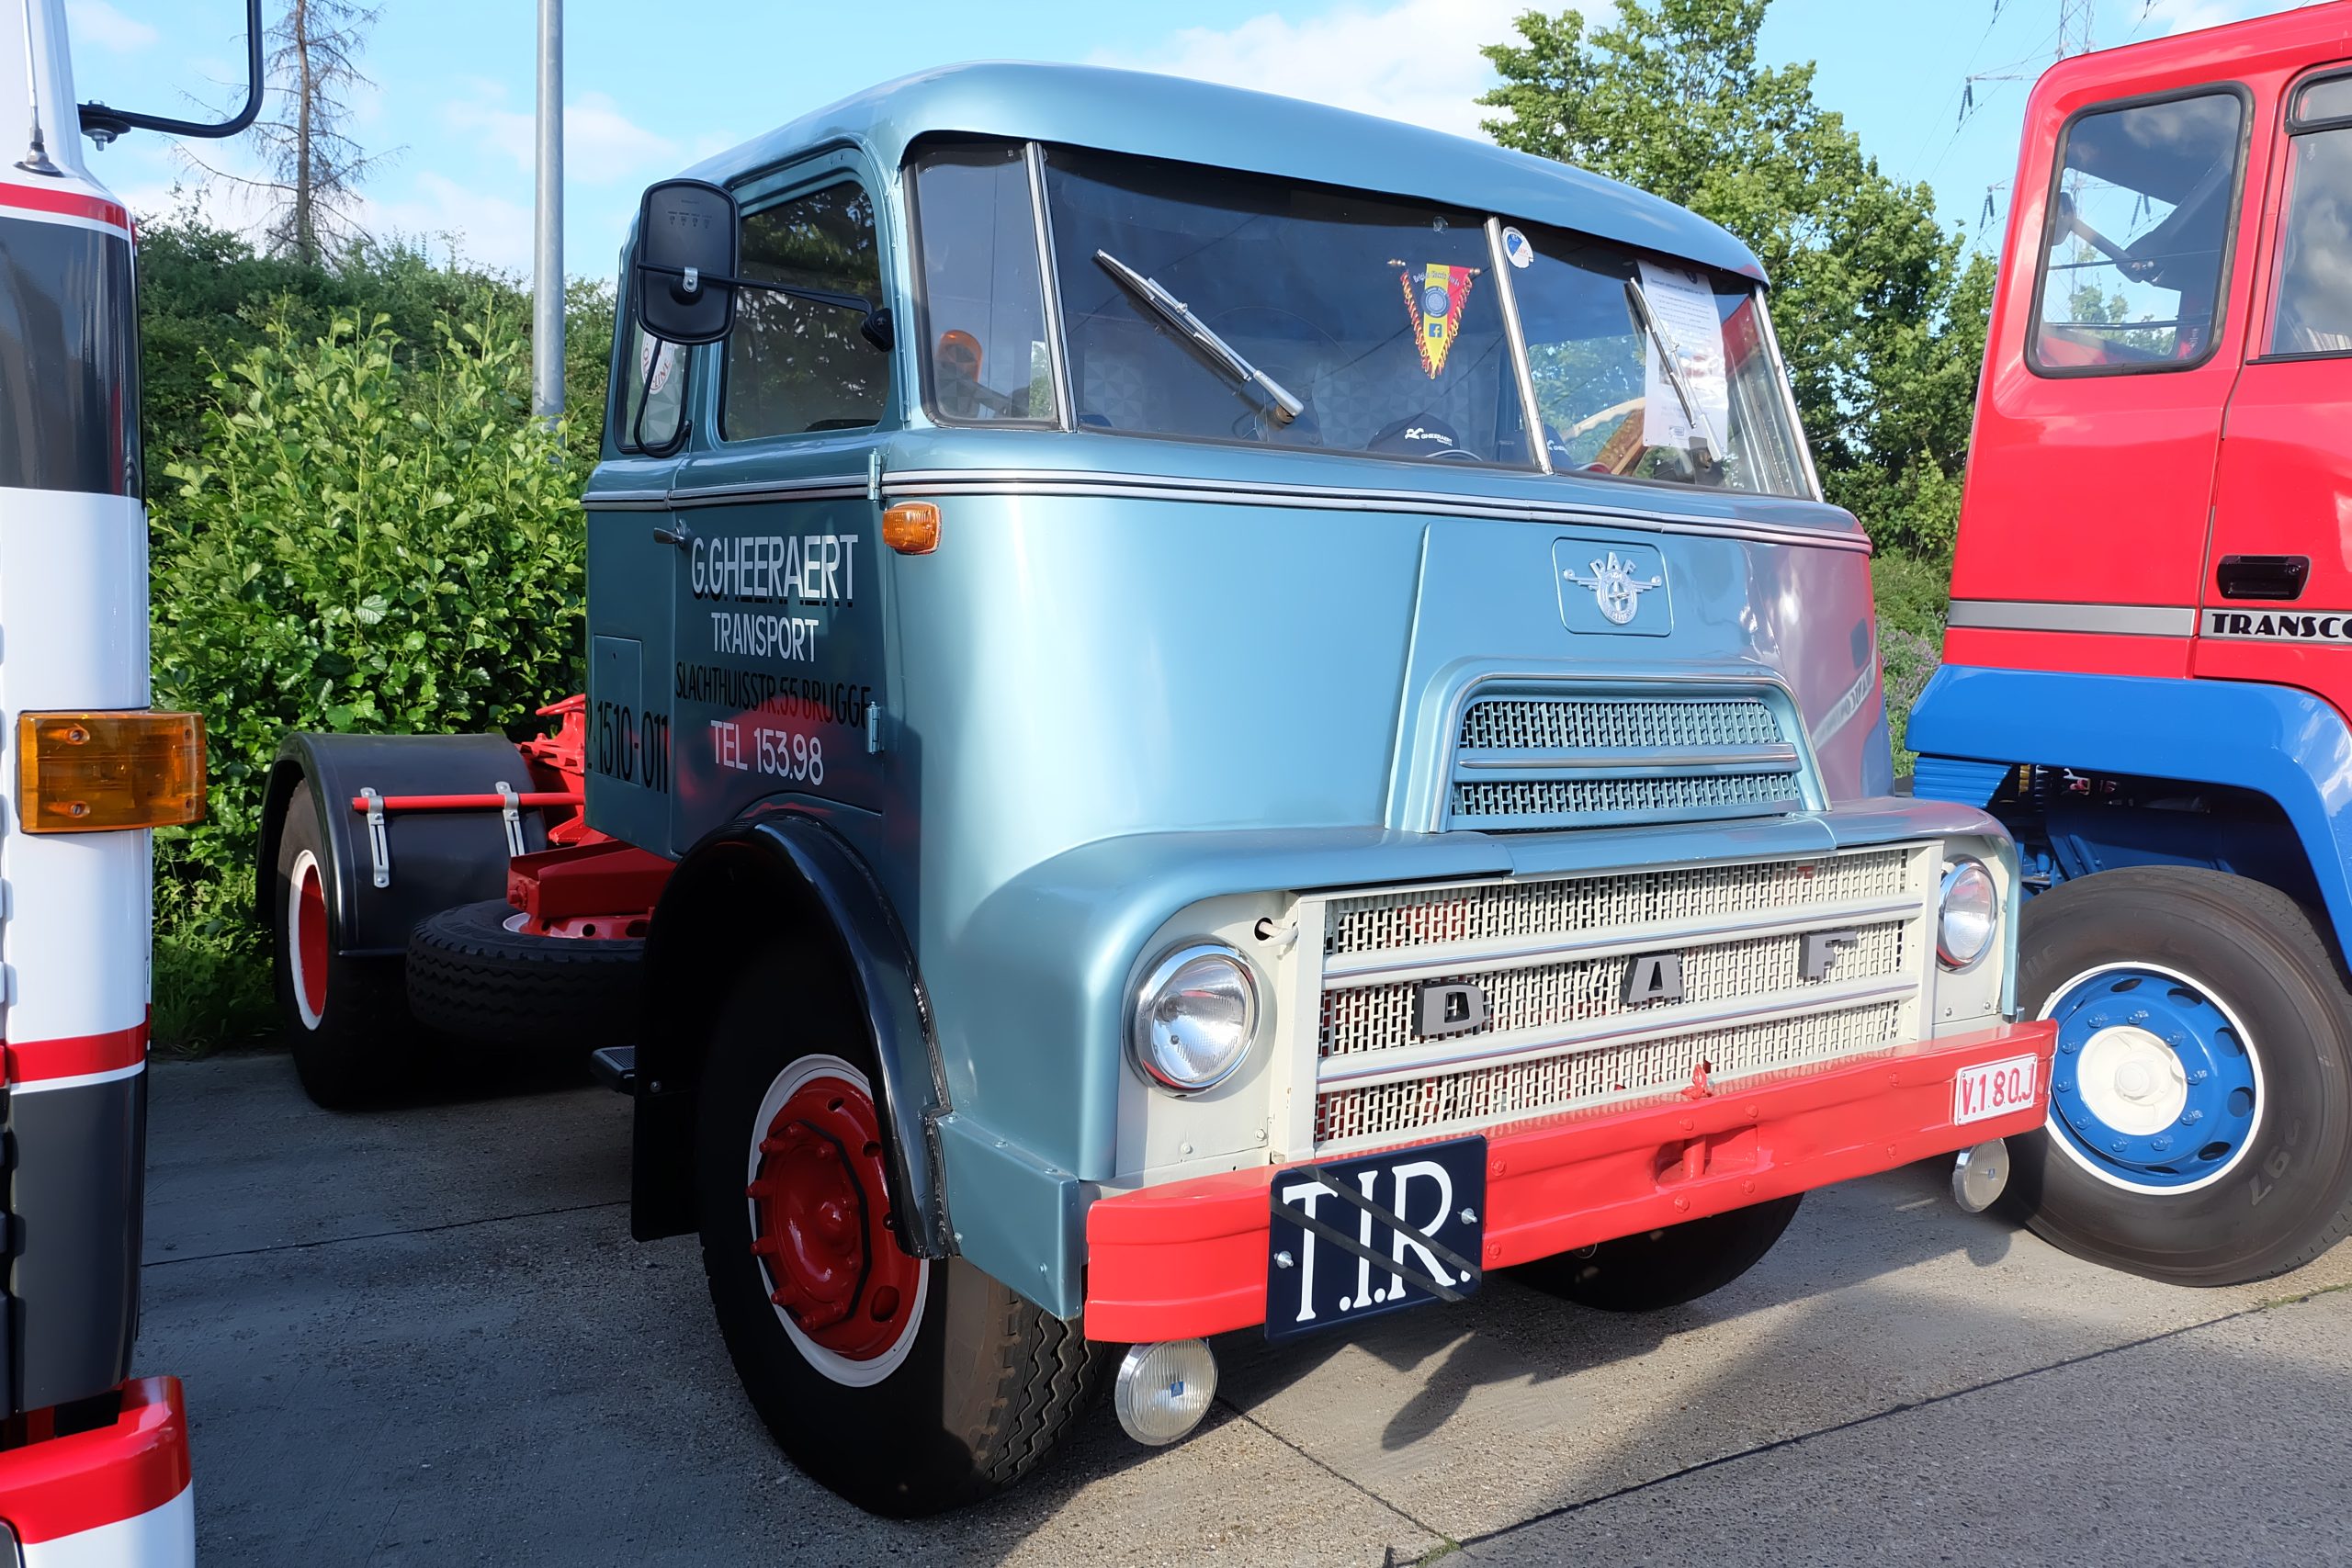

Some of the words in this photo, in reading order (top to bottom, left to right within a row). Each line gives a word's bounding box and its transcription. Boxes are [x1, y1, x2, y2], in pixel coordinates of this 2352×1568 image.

[1589, 551, 1636, 580] DAF
[711, 612, 820, 662] TRANSPORT
[710, 720, 748, 772] TEL
[754, 727, 824, 786] 153.98
